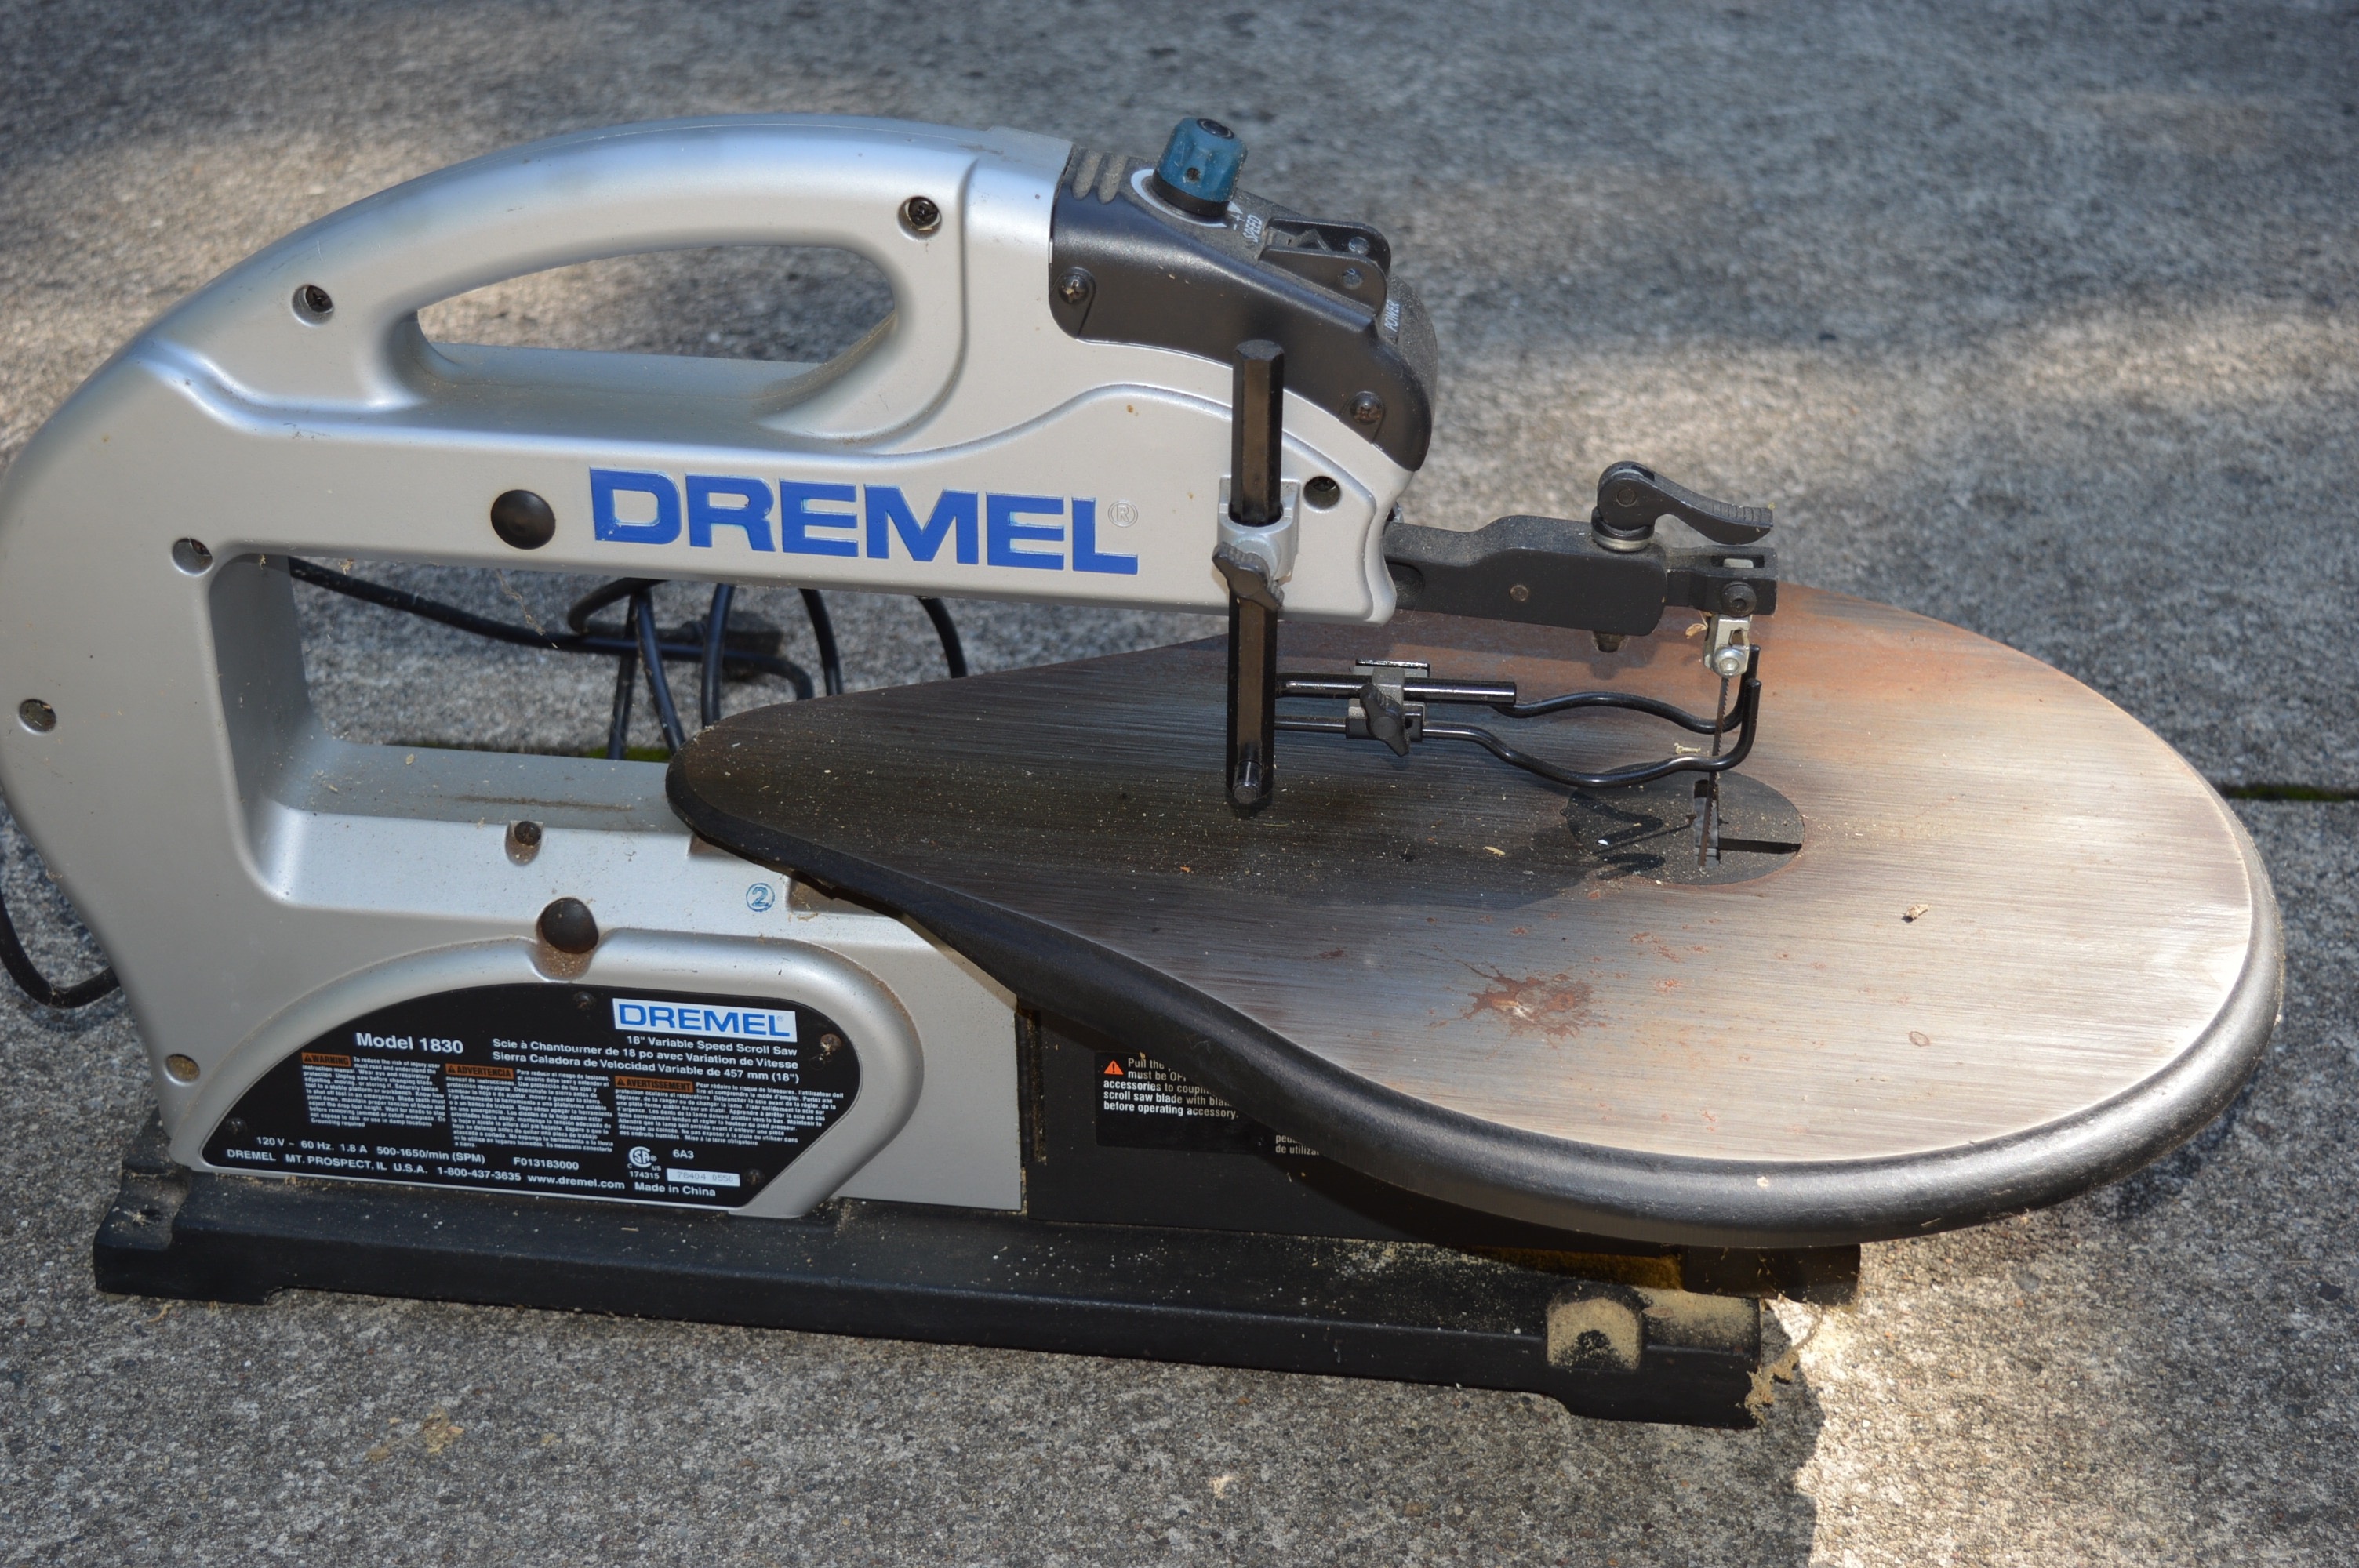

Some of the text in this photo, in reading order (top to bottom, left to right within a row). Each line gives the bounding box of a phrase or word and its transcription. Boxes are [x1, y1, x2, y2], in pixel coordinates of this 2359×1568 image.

[1242, 214, 1262, 243] SPEED
[1384, 299, 1399, 332] POWER
[590, 469, 1138, 574] DREMEL
[619, 1004, 791, 1037] DREMEL
[357, 1033, 463, 1054] Model 1830
[627, 1036, 797, 1055] 18" Variable Speed Scroll Saw
[313, 1054, 350, 1065] WARNING
[493, 1039, 518, 1049] Scie
[521, 1040, 527, 1050] à
[530, 1041, 602, 1055] Chantourner
[605, 1047, 619, 1056] de
[623, 1048, 635, 1058] 18
[639, 1051, 653, 1061] po
[685, 1052, 736, 1065] Variation
[740, 1056, 754, 1065] de
[756, 1058, 798, 1069] Vitesse
[457, 1066, 511, 1078] ADVERTENCIA
[493, 1052, 526, 1062] Sierra
[529, 1054, 580, 1066] Caladora
[583, 1058, 598, 1068] de
[600, 1059, 656, 1072] Velocidad
[658, 1063, 703, 1075] Variable
[707, 1067, 721, 1076] de
[724, 1068, 743, 1078] 457
[772, 1072, 799, 1084] (18")
[1128, 1058, 1147, 1069] Pull
[1149, 1059, 1165, 1069] the
[1128, 1070, 1152, 1080] must
[1155, 1071, 1166, 1080] be
[627, 1079, 692, 1091] AVERTISSEMENT
[1103, 1080, 1161, 1091] accessories
[1165, 1083, 1173, 1092] to
[1103, 1091, 1130, 1100] scroll
[1133, 1094, 1153, 1102] saw
[1156, 1093, 1183, 1104] blade
[1186, 1096, 1205, 1105] with
[1103, 1100, 1239, 1120] before operating accessory.
[257, 1137, 275, 1146] 120
[278, 1138, 285, 1147] V
[301, 1140, 314, 1149] 60
[317, 1142, 334, 1151] Hz.
[340, 1144, 356, 1153] 1.8
[359, 1145, 367, 1154] A
[376, 1146, 449, 1160] 500-1650/min
[452, 1152, 485, 1165] (SPM)
[513, 1156, 580, 1171] F013183000
[672, 1149, 695, 1160] 6A3
[1275, 1144, 1286, 1153] de
[227, 1149, 276, 1162] DREMEL
[285, 1154, 305, 1163] MT.
[376, 1161, 387, 1170] IL
[394, 1163, 428, 1173] U.S.A.
[438, 1166, 521, 1181] 1-800-437-3635
[528, 1173, 624, 1189] www.dremel.com
[629, 1171, 660, 1180] 174315
[634, 1181, 715, 1196] Made in China
